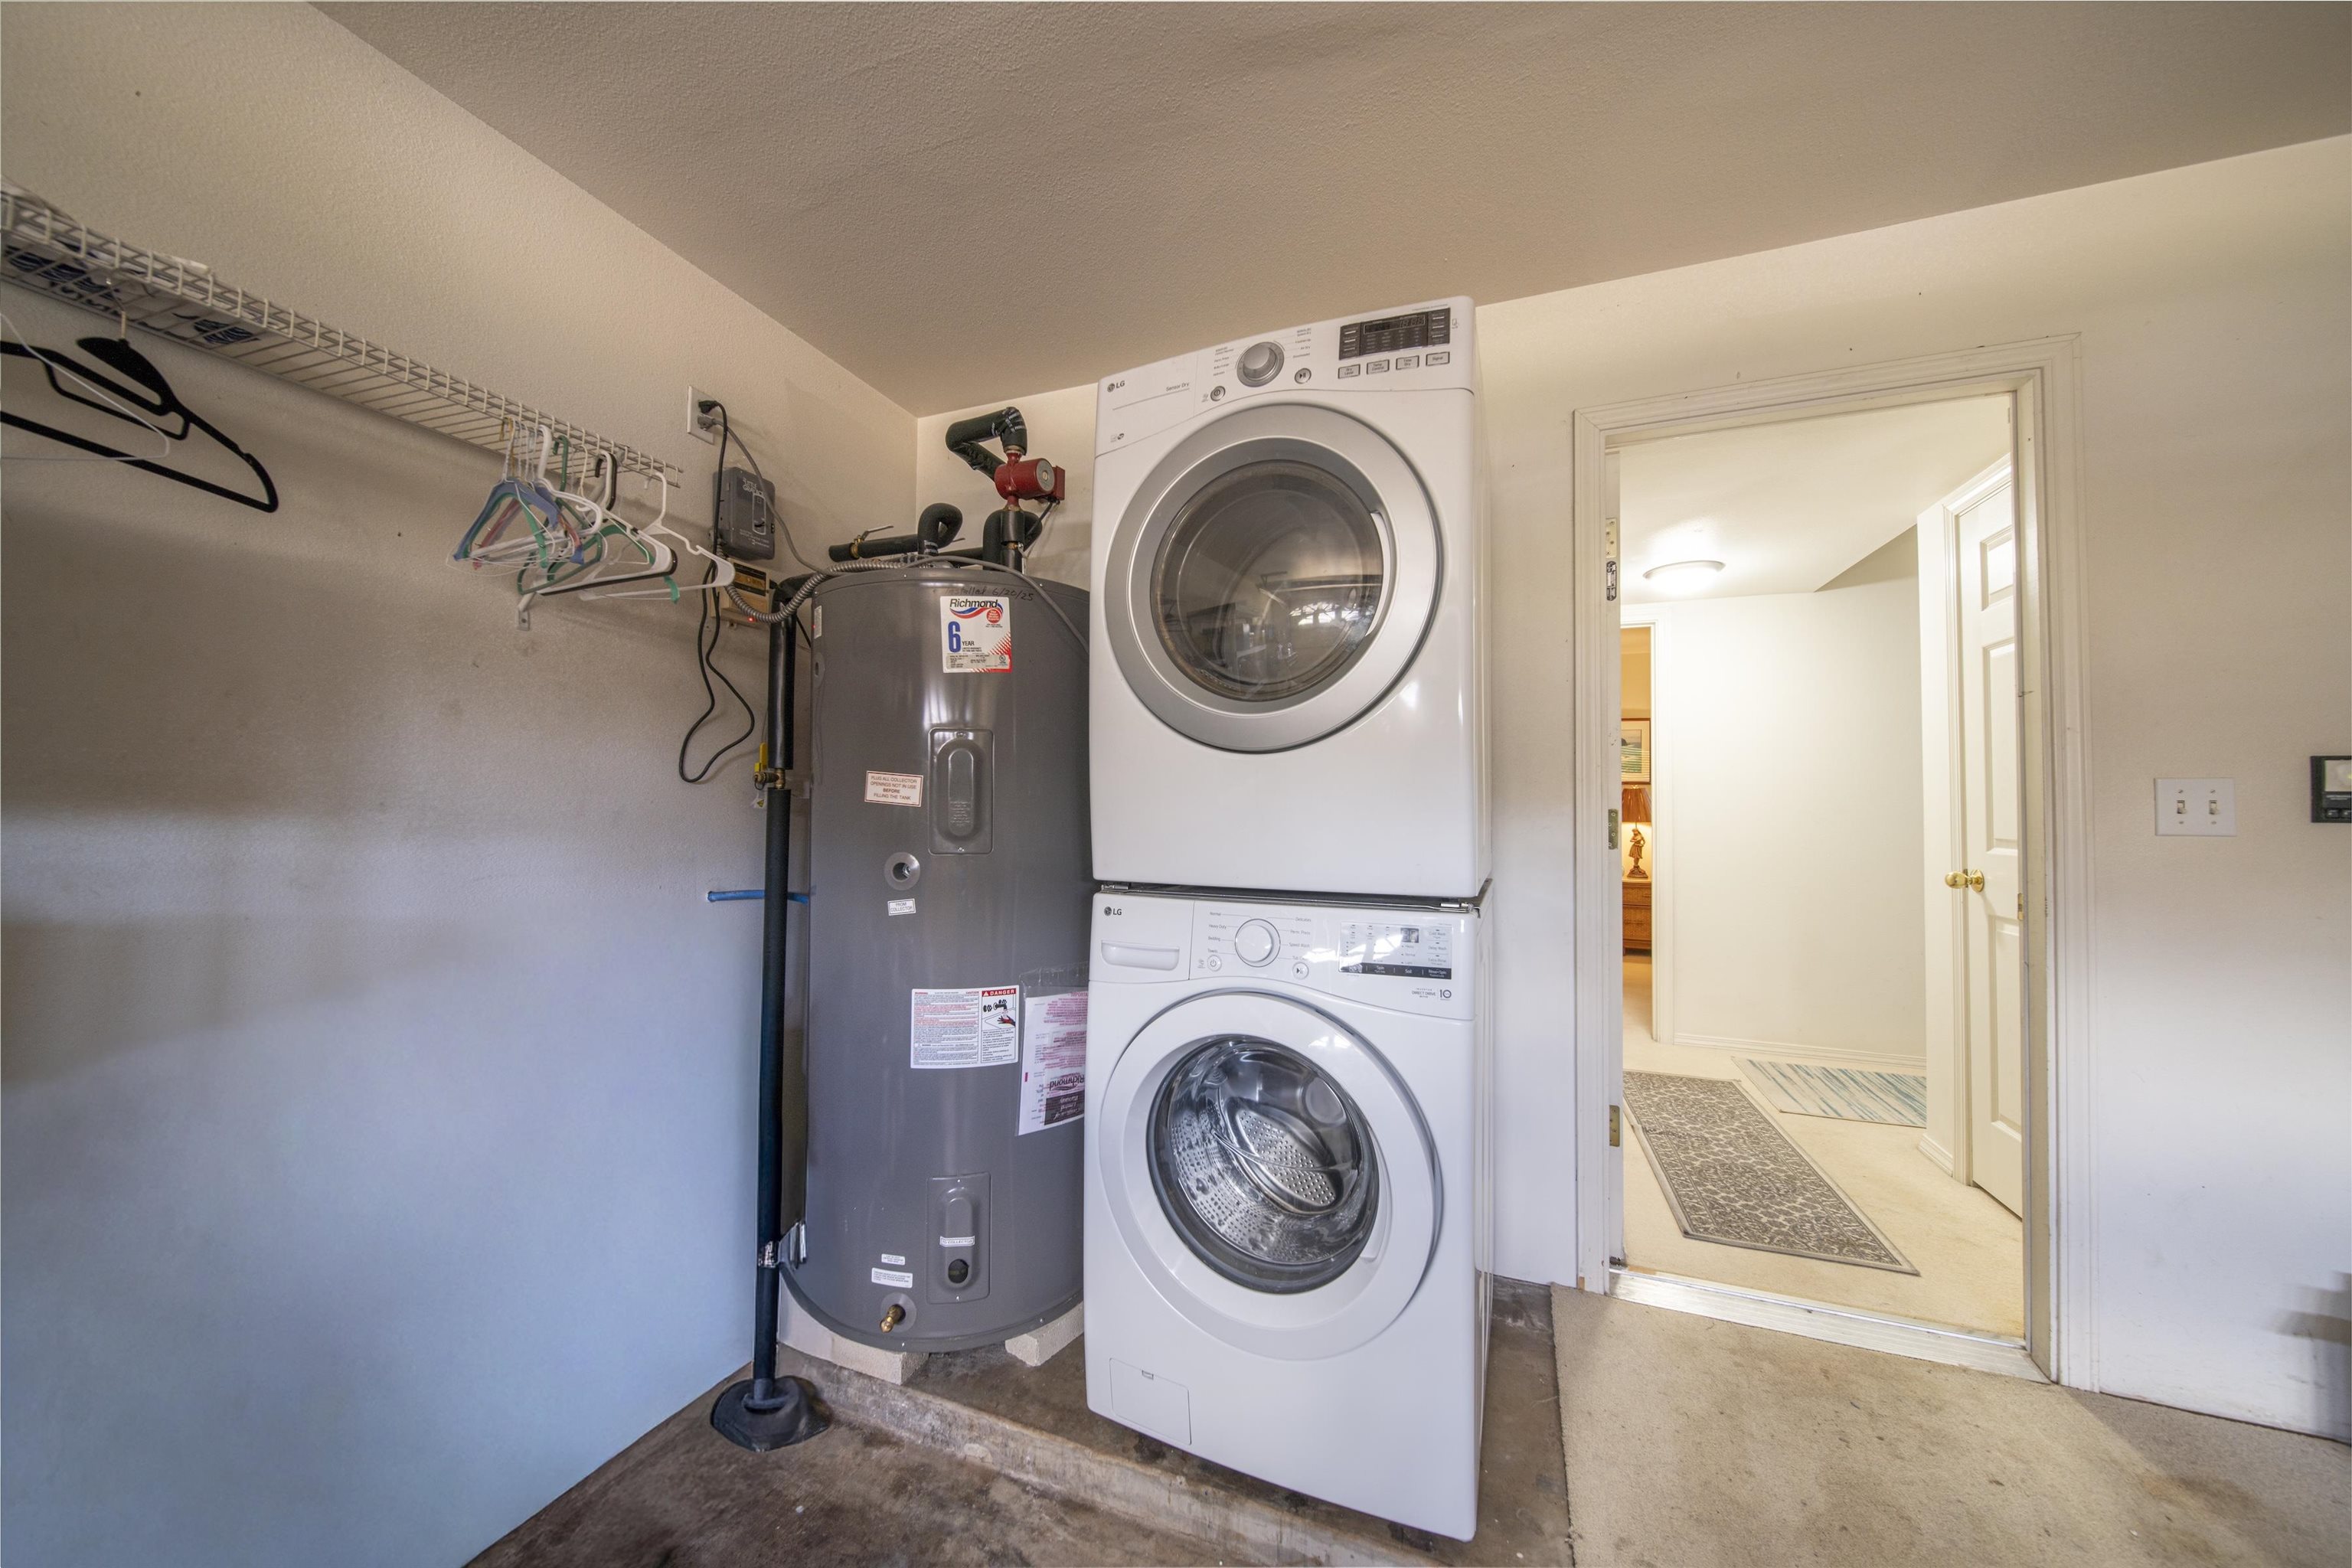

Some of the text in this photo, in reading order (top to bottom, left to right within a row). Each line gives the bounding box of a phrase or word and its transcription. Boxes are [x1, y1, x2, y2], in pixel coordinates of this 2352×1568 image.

[1116, 380, 1125, 389] LG
[991, 587, 1034, 601] 6/20/25
[949, 598, 998, 608] Richmond
[948, 621, 961, 653] 6
[1049, 1074, 1085, 1091] Richmond
